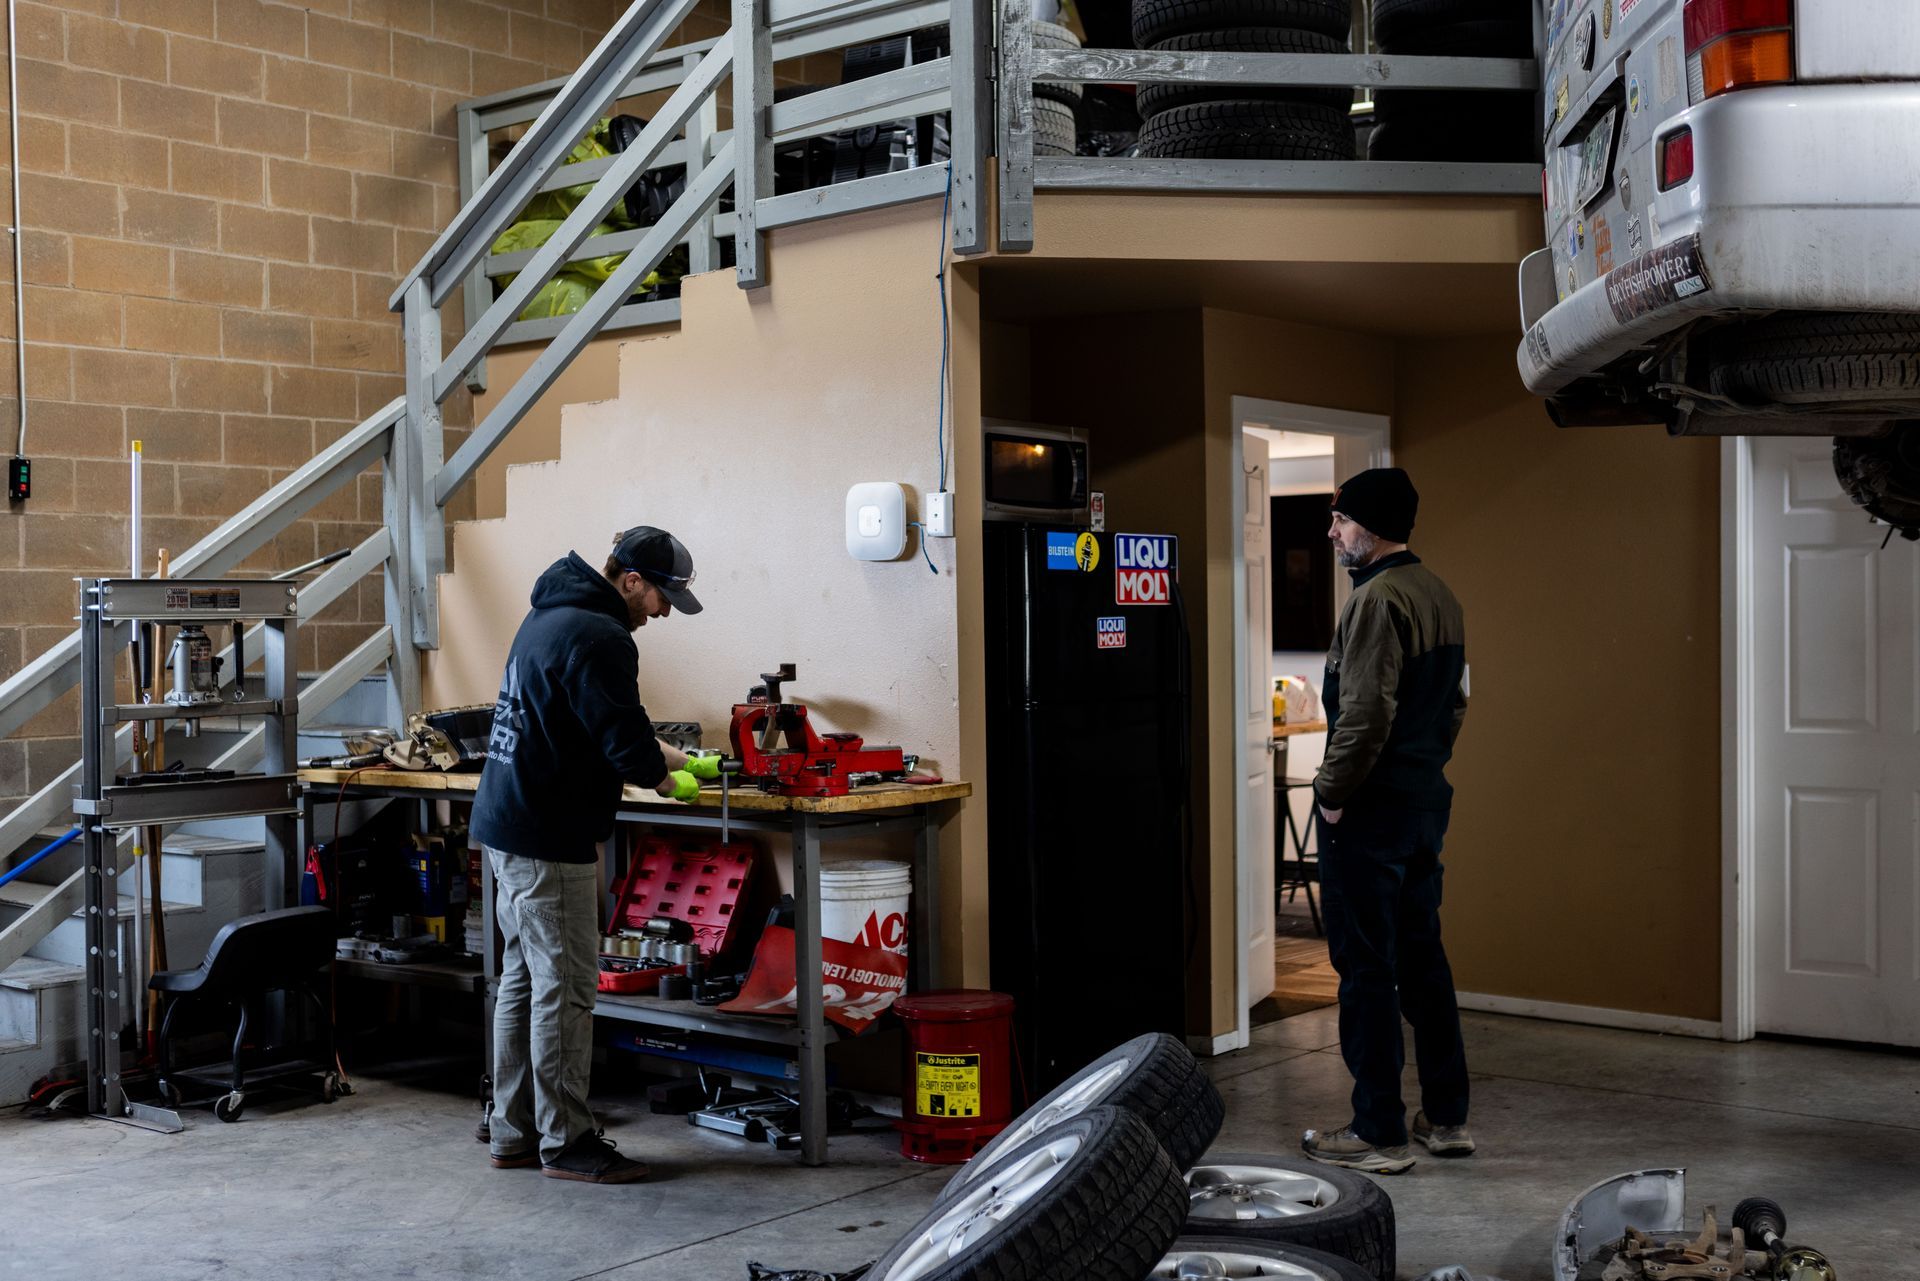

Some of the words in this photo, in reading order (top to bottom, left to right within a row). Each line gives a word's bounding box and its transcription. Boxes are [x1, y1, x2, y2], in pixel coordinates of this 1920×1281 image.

[1643, 256, 1693, 288] POWER!
[1048, 546, 1075, 557] BILSTEIN
[1099, 619, 1124, 632] LIQUI
[1099, 633, 1125, 646] MOLY
[490, 723, 520, 753] RO
[822, 961, 847, 981] LEA
[846, 968, 906, 989] HNOLOGY
[935, 1056, 966, 1065] Justrite
[926, 1080, 939, 1090] EMPTY
[940, 1081, 954, 1091] EVERY
[956, 1082, 969, 1091] NIGHT
